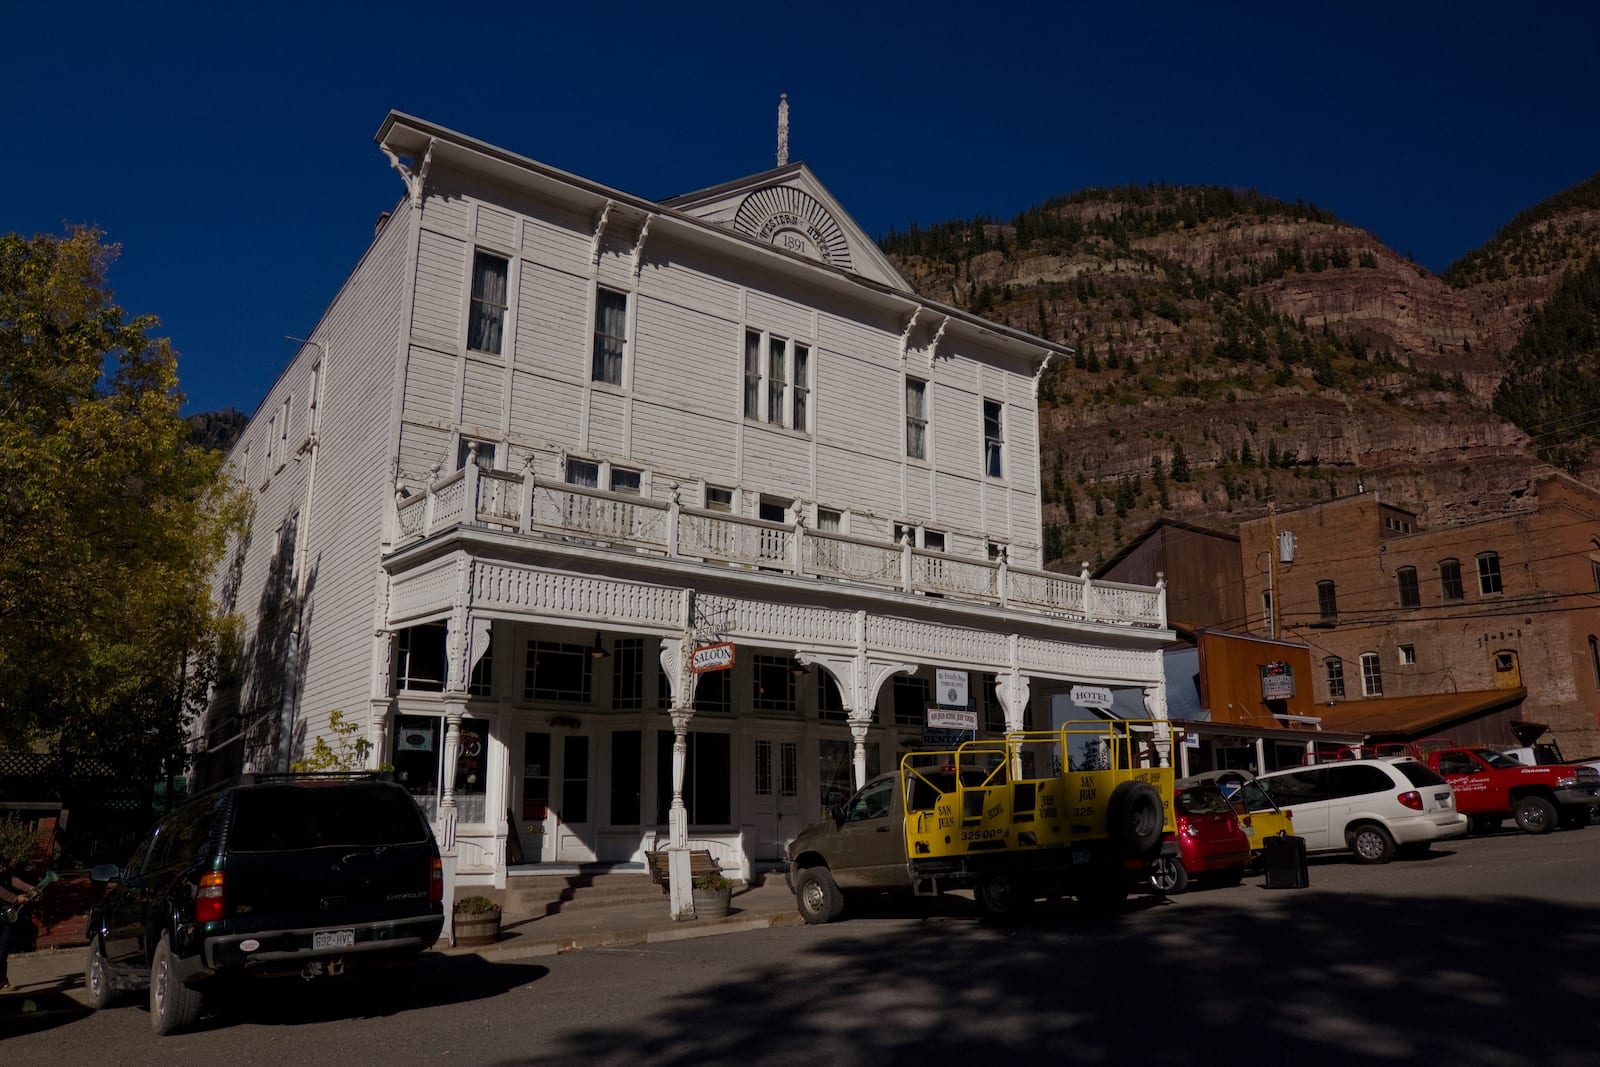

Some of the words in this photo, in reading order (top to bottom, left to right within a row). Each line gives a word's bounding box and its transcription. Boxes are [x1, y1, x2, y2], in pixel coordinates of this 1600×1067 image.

[760, 215, 798, 239] WESTERN
[784, 235, 806, 253] 1891
[694, 648, 731, 665] SALOON
[1076, 692, 1110, 702] HOTEL
[1080, 776, 1096, 787] SAN
[1079, 788, 1096, 802] JUAN
[938, 806, 952, 816] SAN
[938, 817, 954, 829] JUAN
